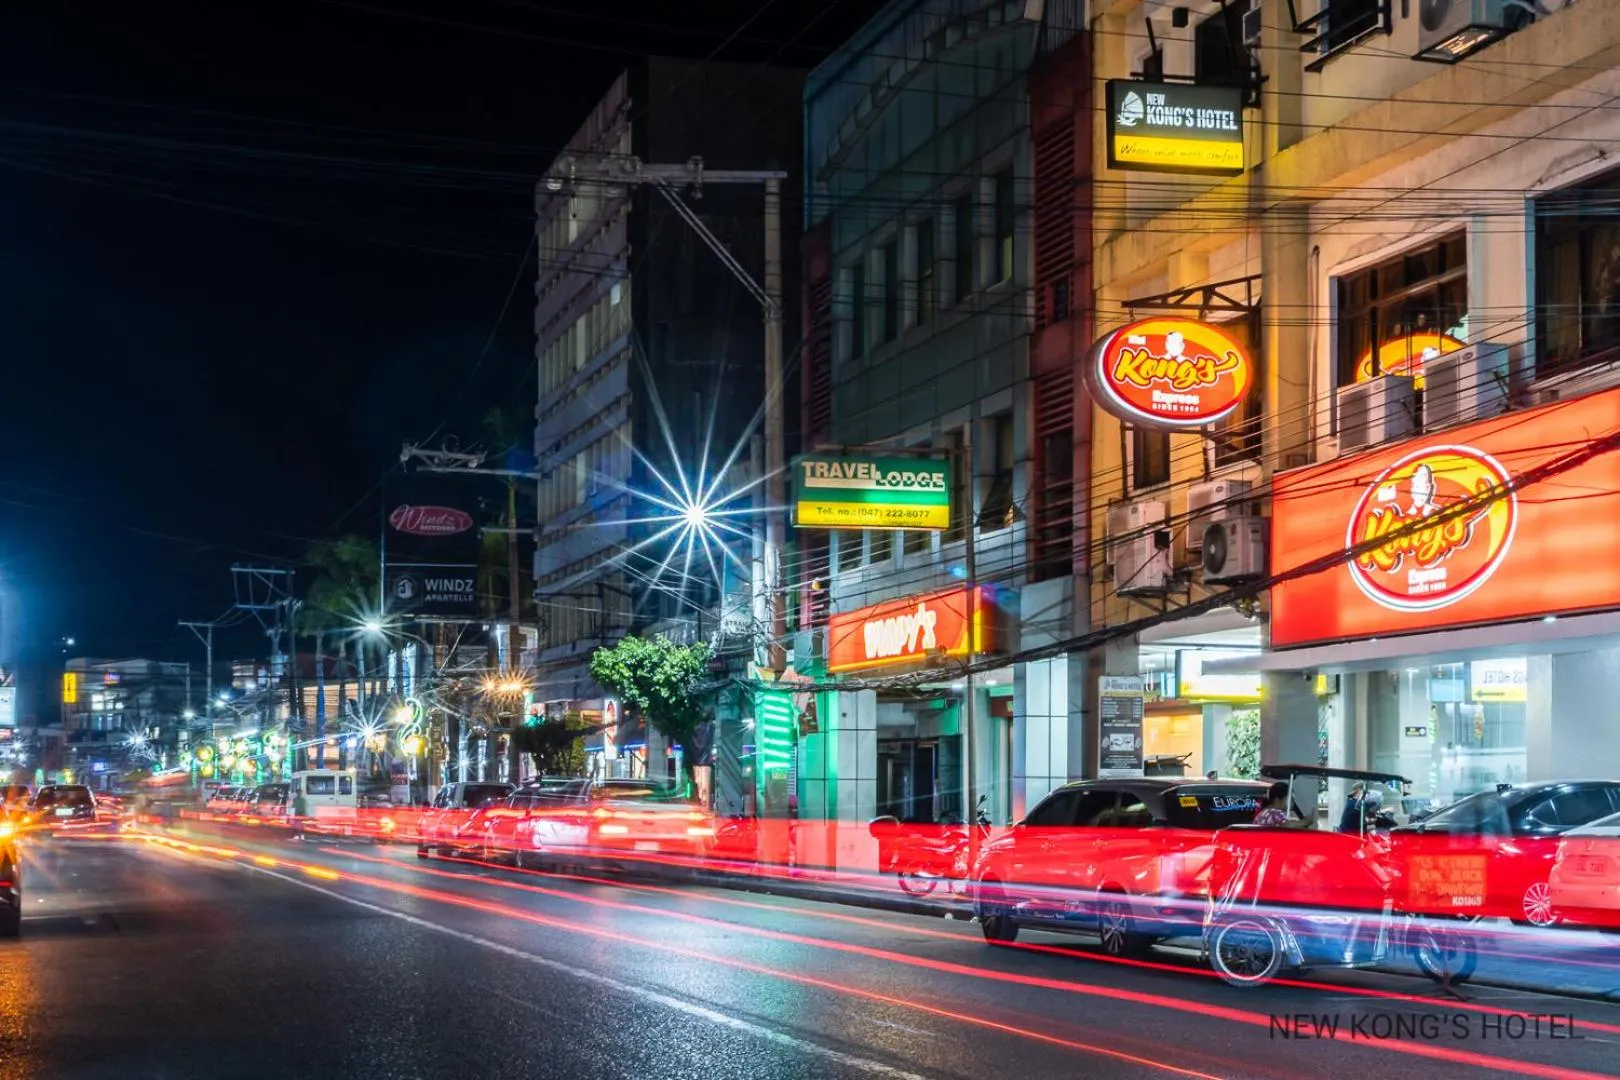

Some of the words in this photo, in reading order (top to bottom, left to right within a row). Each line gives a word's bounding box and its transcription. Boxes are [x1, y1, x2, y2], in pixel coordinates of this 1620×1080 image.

[1146, 93, 1166, 106] NEW
[1146, 106, 1194, 127] KONG'S
[1196, 109, 1238, 130] HOTEL
[1113, 349, 1239, 388] Kong's
[802, 461, 877, 479] TRAVEL
[875, 471, 944, 488] LODGE
[425, 579, 474, 592] WINDZ
